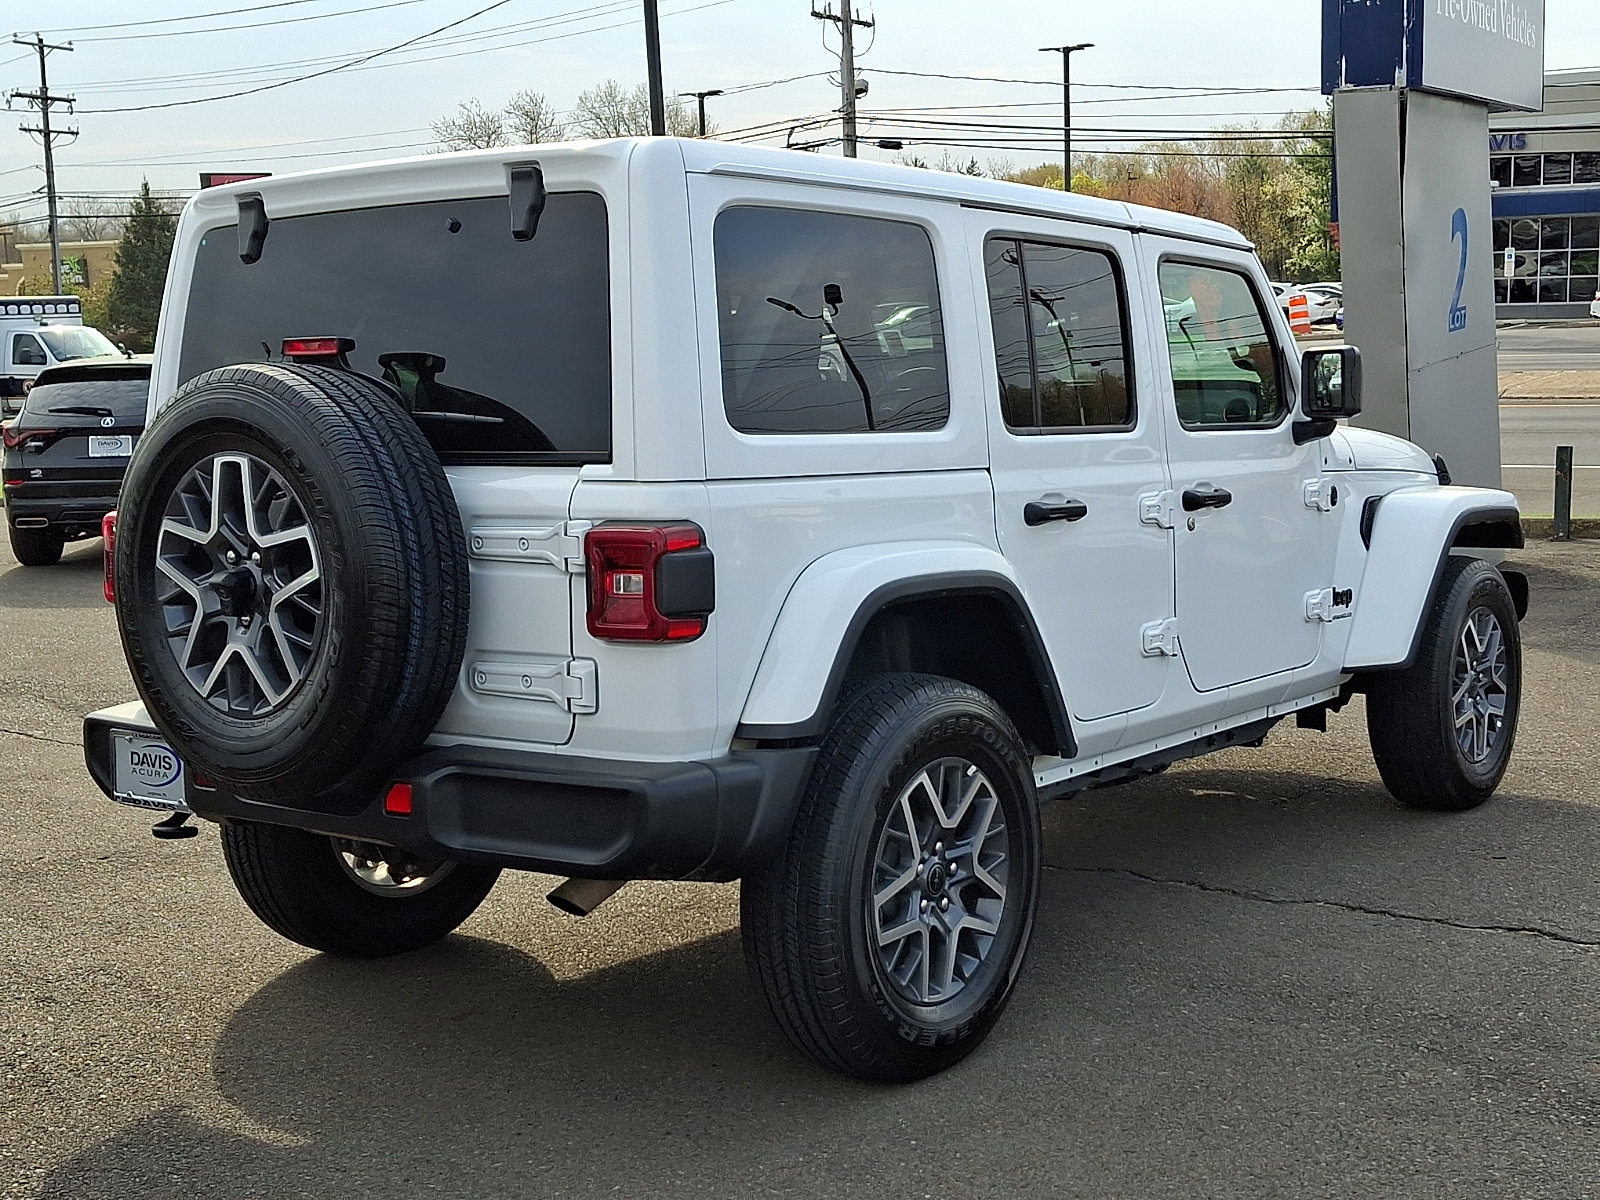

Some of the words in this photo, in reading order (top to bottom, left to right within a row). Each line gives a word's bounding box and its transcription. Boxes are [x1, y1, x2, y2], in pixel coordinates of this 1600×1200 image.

[1500, 0, 1536, 48] Vehicles
[1448, 207, 1468, 332] 2
[1449, 310, 1466, 329] LOT
[1331, 586, 1353, 608] Jeep
[130, 750, 173, 771] DAVIS
[131, 767, 169, 779] ACURA
[132, 799, 177, 810] DAVIS
